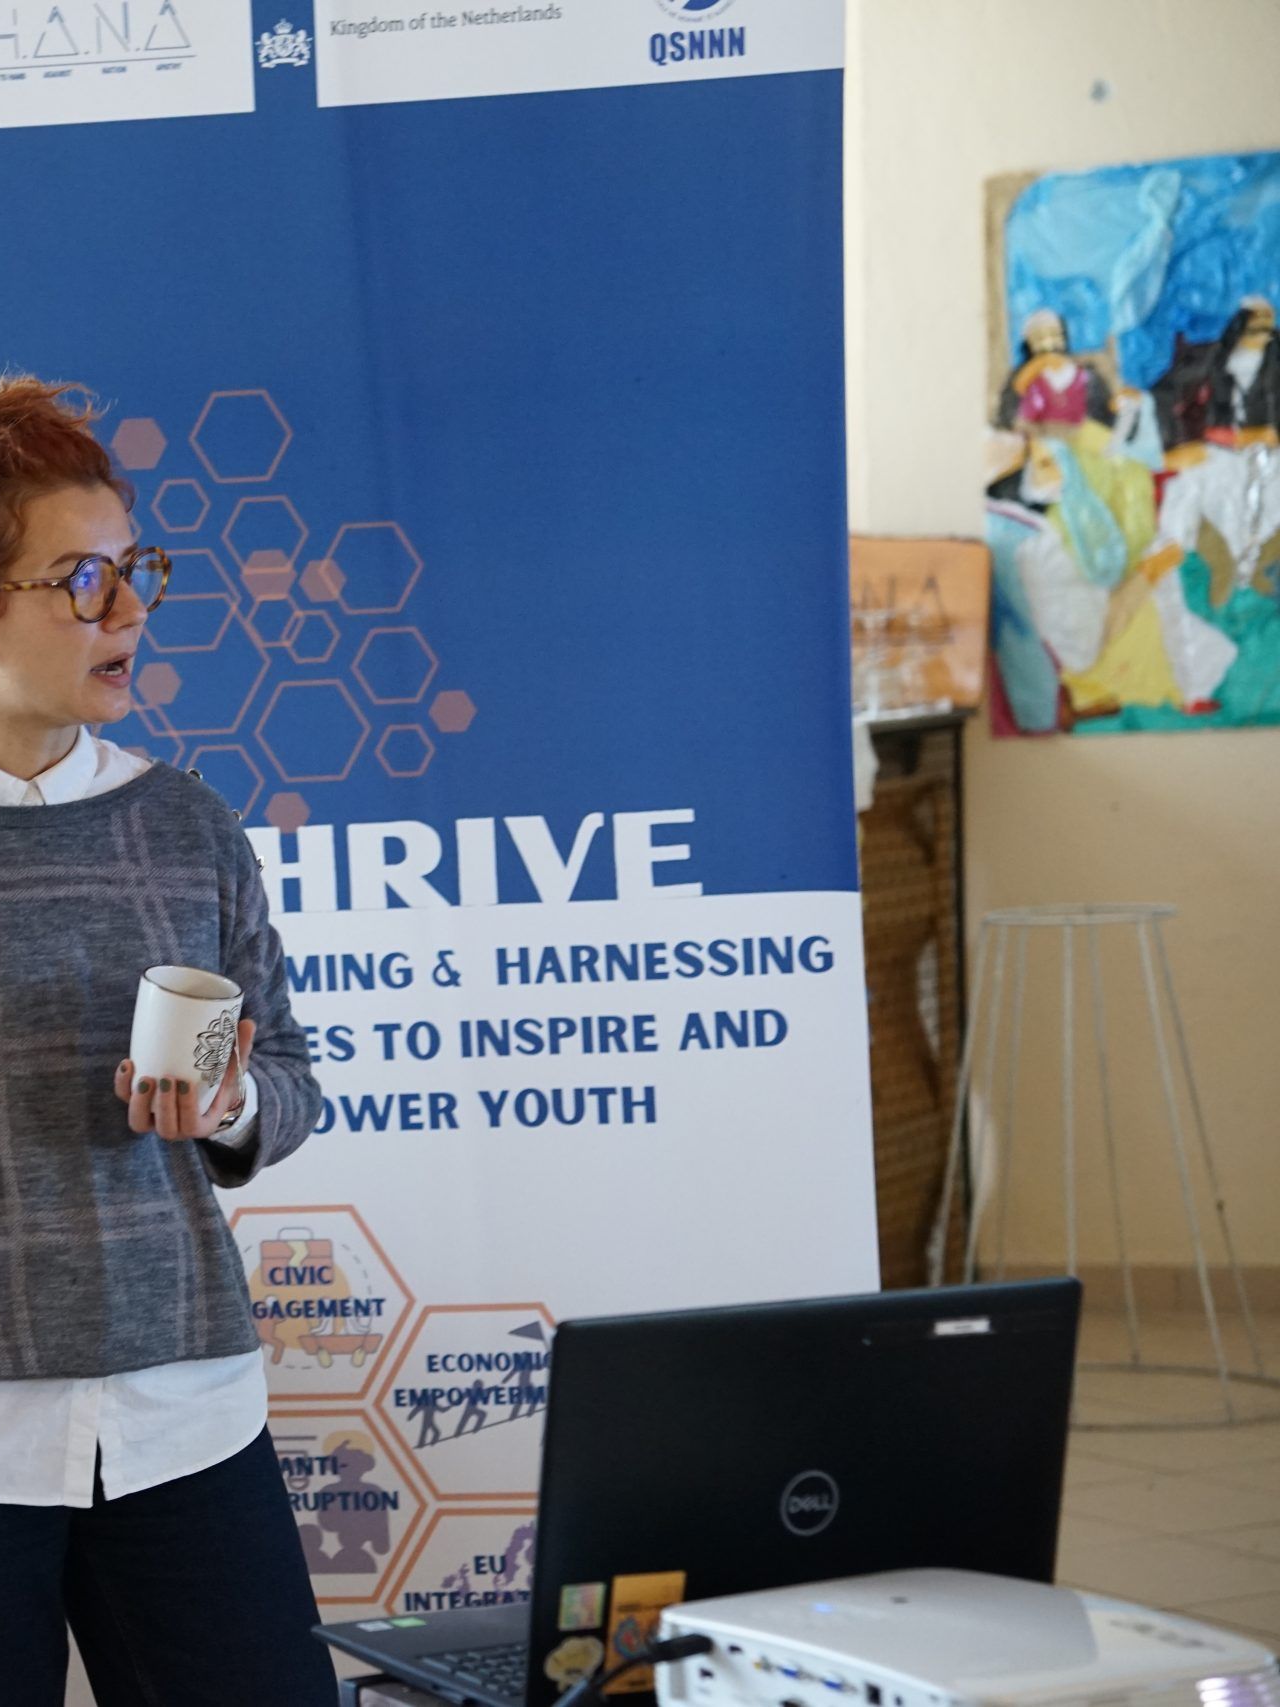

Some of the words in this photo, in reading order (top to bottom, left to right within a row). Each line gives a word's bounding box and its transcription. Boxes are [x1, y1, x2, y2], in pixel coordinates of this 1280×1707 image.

[330, 17, 404, 38] Kingdom
[408, 13, 426, 30] of
[430, 12, 456, 29] the
[461, 3, 562, 27] Netherlands
[650, 26, 745, 66] QSNNN
[432, 950, 462, 988] &
[496, 935, 835, 986] HARNESSING
[374, 1021, 441, 1061] TO
[460, 1015, 659, 1059] INSPIRE
[679, 1009, 788, 1052] AND
[478, 1086, 657, 1128] YOUTH
[269, 1266, 332, 1286] CIVIC
[252, 1298, 386, 1319] GAGEMENT
[787, 1494, 834, 1514] DELL
[473, 1555, 507, 1575] EU
